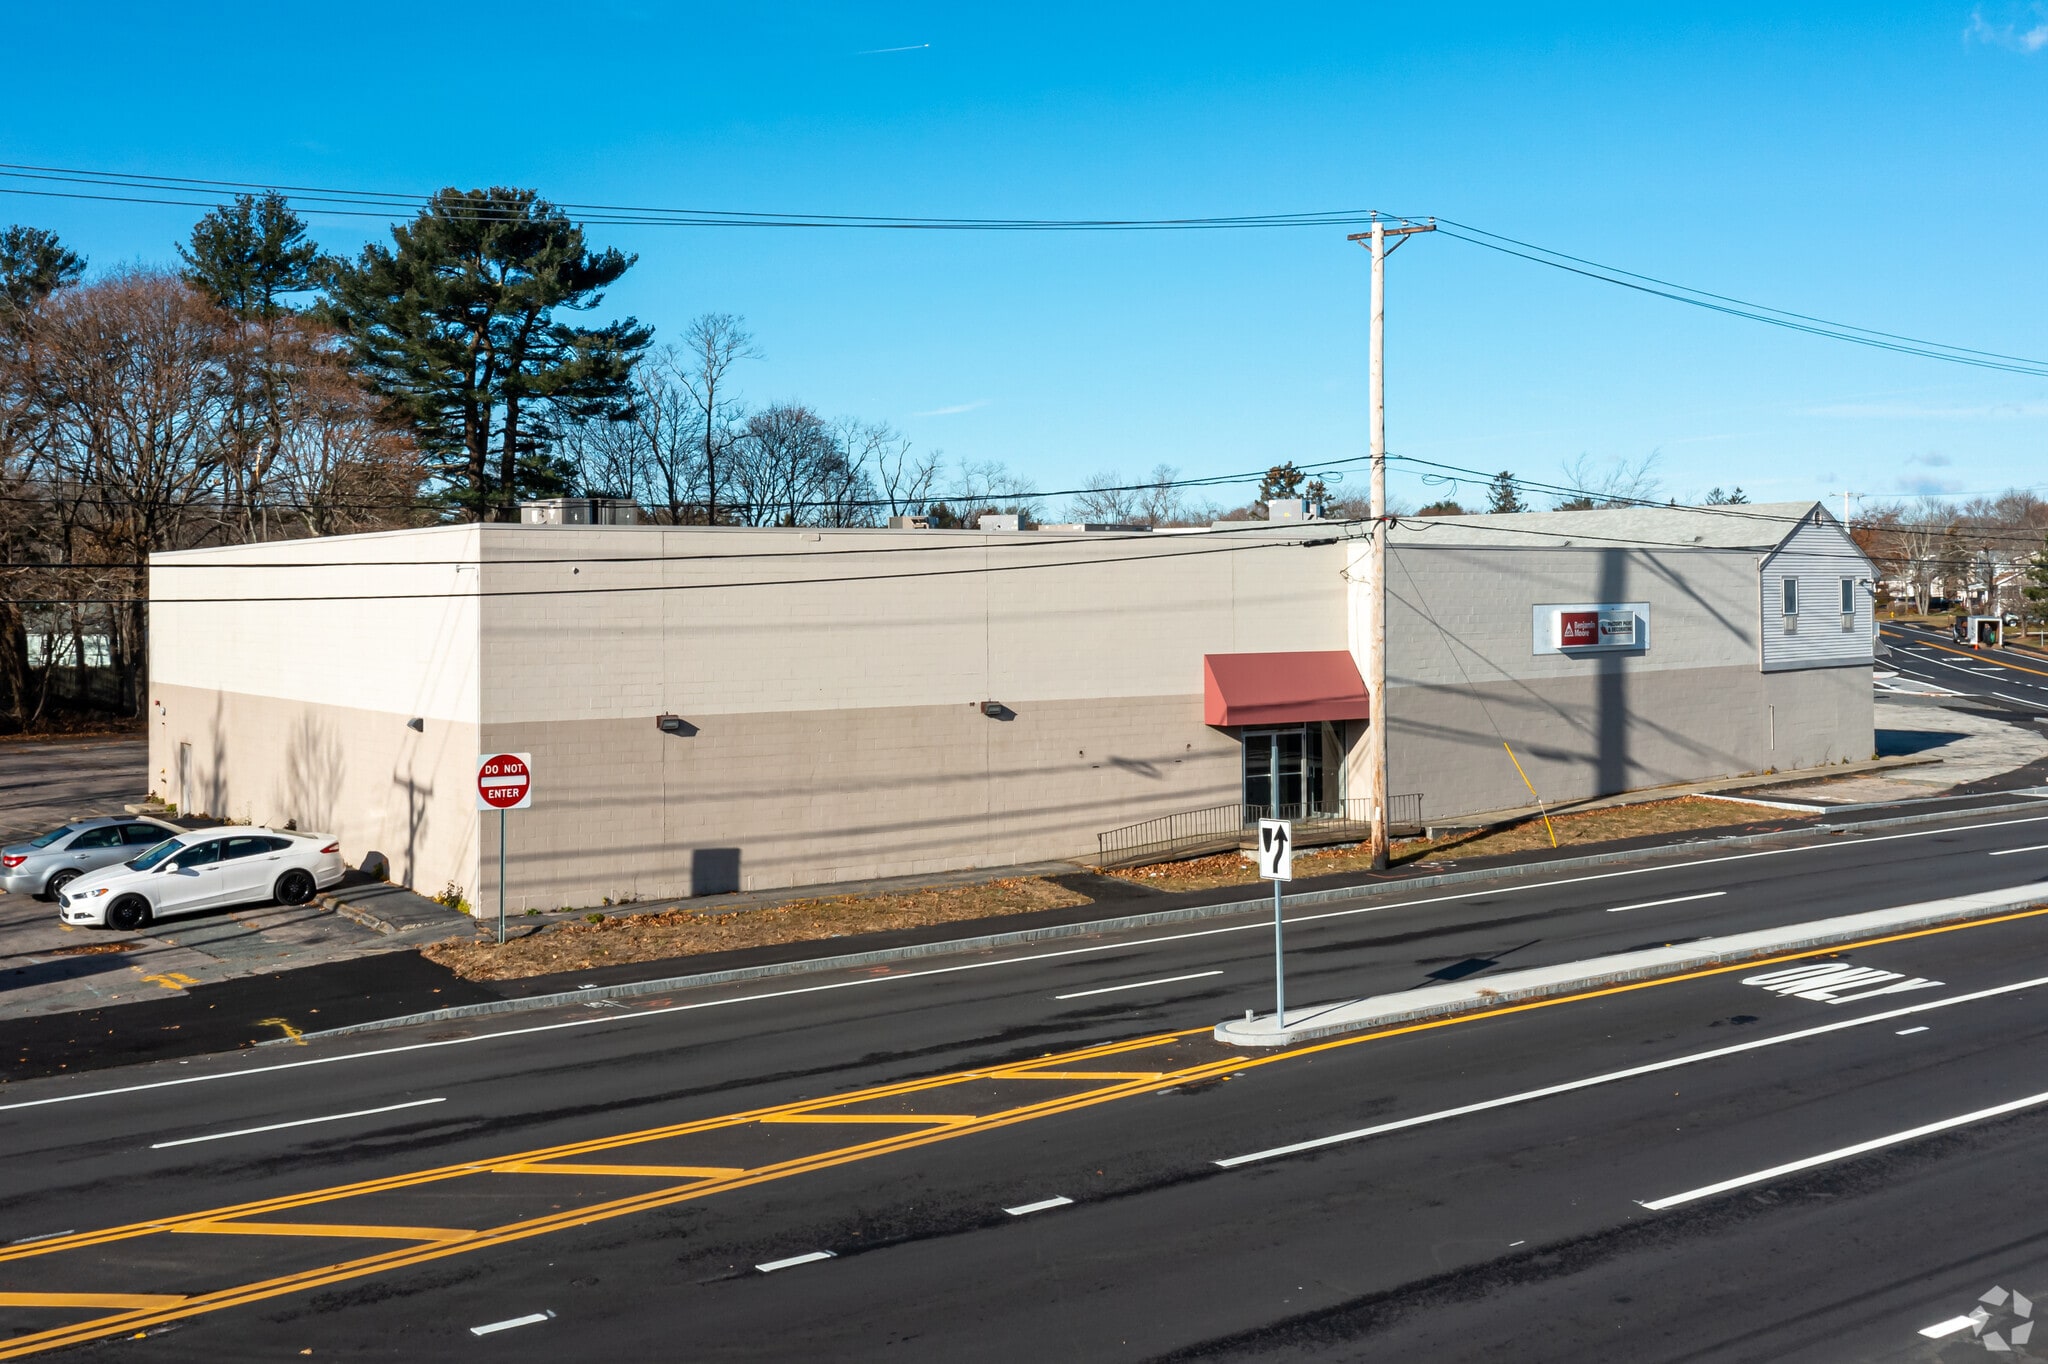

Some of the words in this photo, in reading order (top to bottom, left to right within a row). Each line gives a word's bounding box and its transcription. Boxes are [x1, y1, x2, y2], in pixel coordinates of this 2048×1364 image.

[1574, 621, 1595, 629] Benjamin
[485, 765, 499, 774] DO
[504, 763, 523, 773] NOT
[488, 788, 519, 798] ENTER
[1741, 963, 1946, 1005] ONLY
